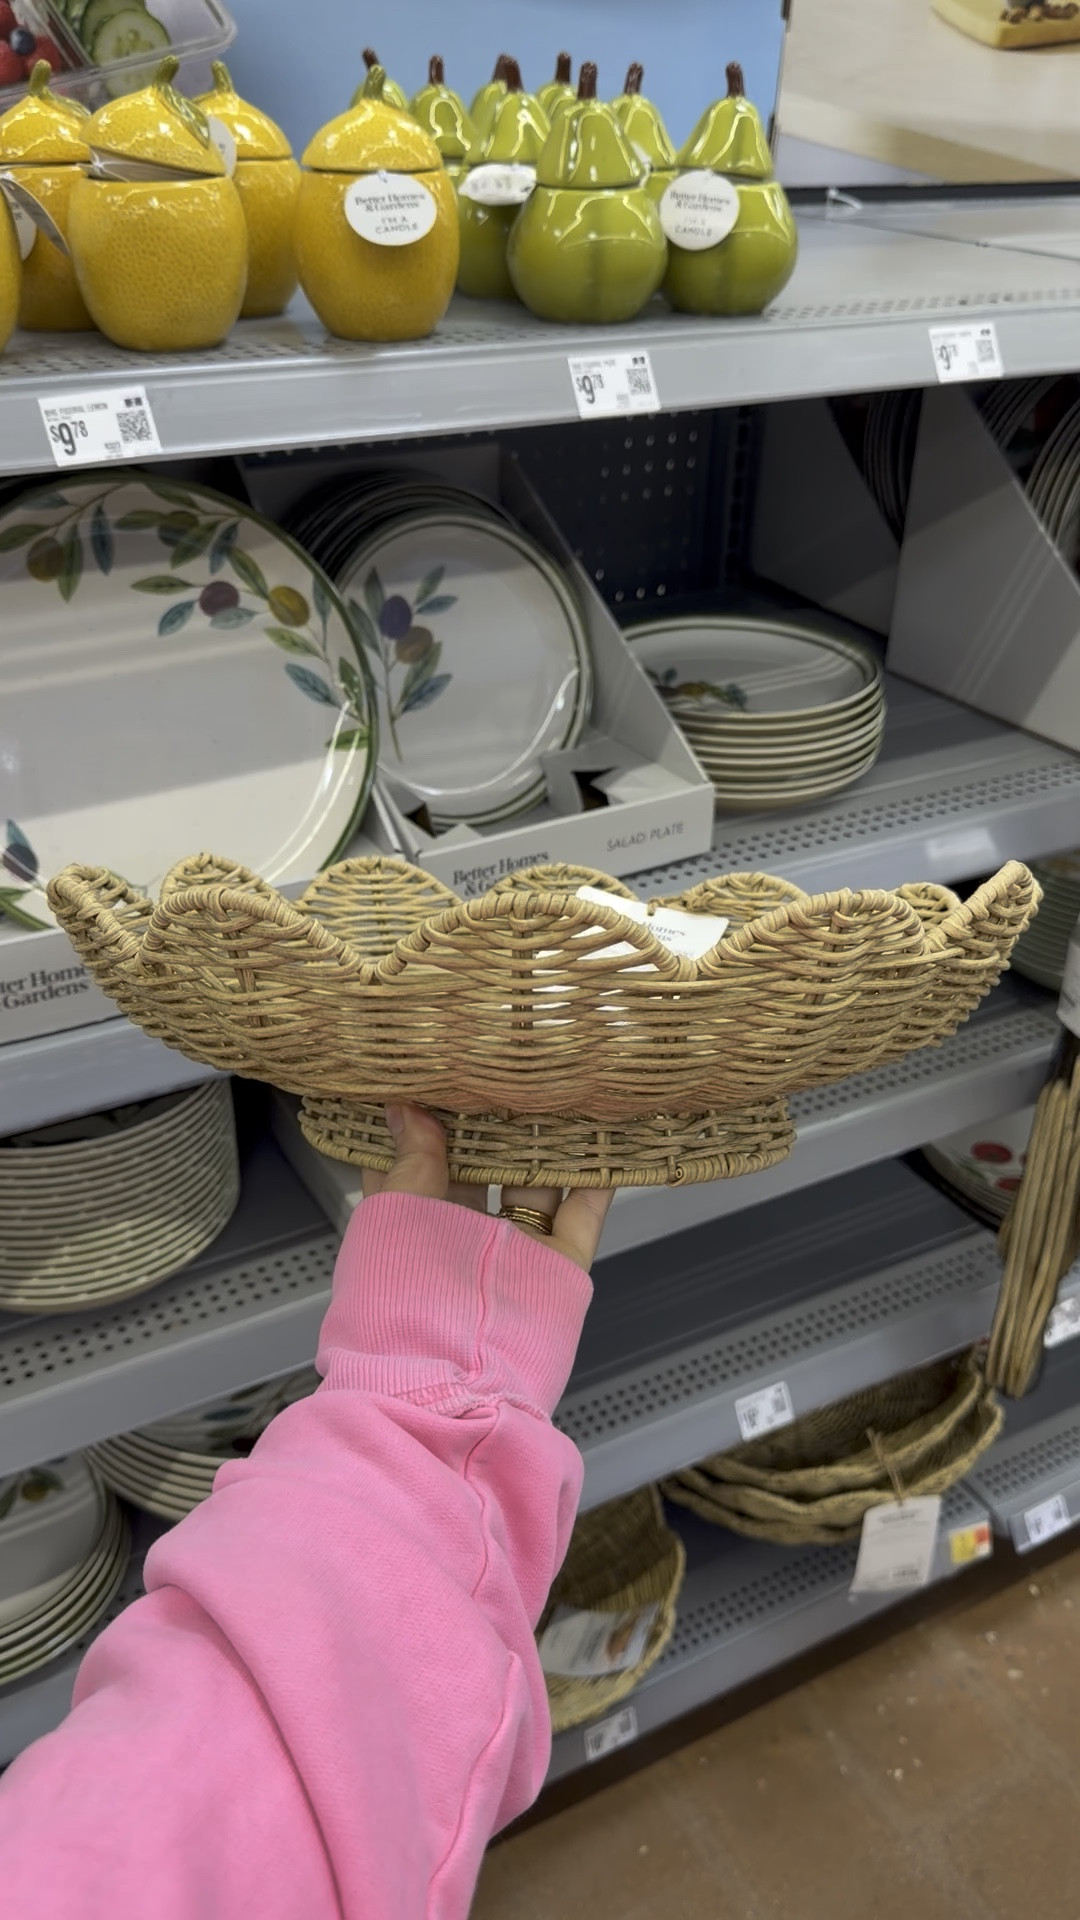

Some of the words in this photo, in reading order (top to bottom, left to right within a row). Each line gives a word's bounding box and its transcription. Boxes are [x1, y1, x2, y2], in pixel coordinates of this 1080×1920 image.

[375, 222, 418, 234] CANDLE
[606, 832, 646, 851] SALAD
[650, 821, 685, 840] PLATE
[453, 864, 497, 886] Better
[499, 852, 549, 873] Homes
[0, 978, 27, 995] ter
[3, 983, 88, 1009] Gardens
